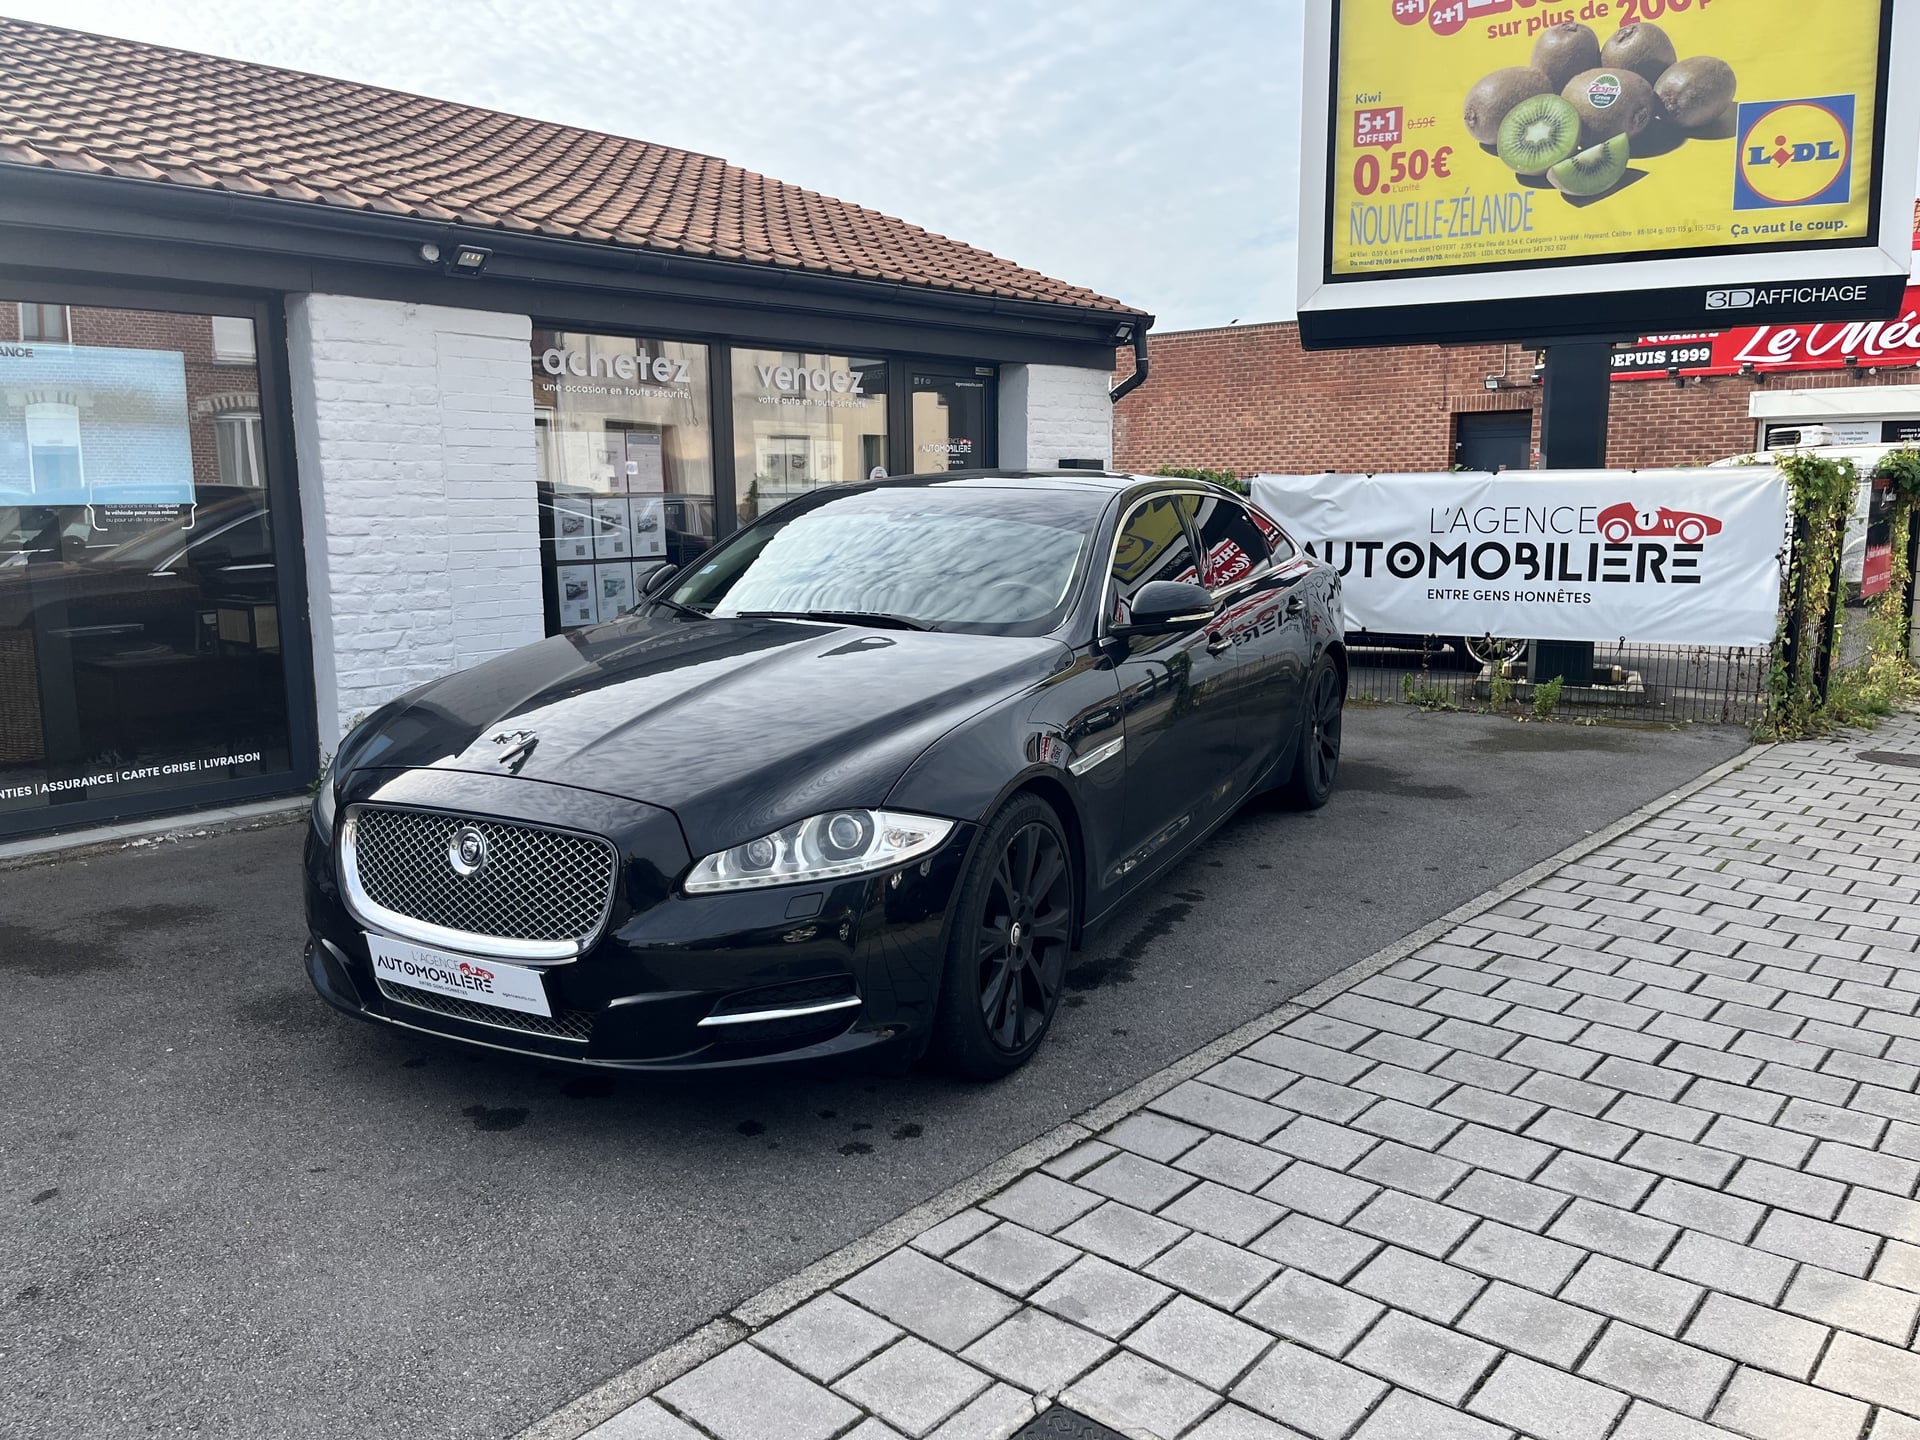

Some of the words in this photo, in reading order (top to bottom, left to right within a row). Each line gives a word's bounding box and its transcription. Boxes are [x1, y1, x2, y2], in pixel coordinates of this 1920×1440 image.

[1396, 0, 1425, 15] 5+1
[1433, 2, 1464, 25] 2+1
[1487, 19, 1522, 39] sur
[1526, 9, 1575, 37] plus
[1579, 1, 1609, 21] de
[1355, 92, 1382, 104] Kiwi
[1358, 111, 1396, 133] 5+1
[1407, 116, 1436, 130] 0.59€
[1357, 131, 1399, 144] OFFERT
[1353, 146, 1454, 196] 0.50€
[1350, 187, 1536, 246] NOUVELLE-ZÉLANDE
[1731, 224, 1749, 238] Ça
[1753, 222, 1786, 234] vaut
[1790, 220, 1803, 231] le
[1807, 220, 1848, 232] coup.
[1755, 285, 1868, 305] AFFICHAGE
[1671, 347, 1710, 363] 1999
[1733, 326, 1801, 363] Le
[542, 347, 691, 383] achetez
[757, 358, 864, 394] vendez
[543, 383, 561, 391] une
[565, 383, 607, 394] occasion
[610, 387, 622, 395] en
[625, 387, 650, 396] toute
[758, 395, 779, 405] votre
[781, 398, 800, 406] auto
[1430, 506, 1597, 534] L'AGENCE
[1642, 513, 1650, 526] 1
[1428, 589, 1469, 600] ENTRE
[1473, 590, 1510, 601] GENS
[1515, 588, 1591, 604] HONNÊTES
[40, 773, 114, 793] ASSURANCE
[122, 766, 160, 781] CARTE
[162, 761, 197, 774] GRISE
[204, 751, 261, 768] LIVRAISON
[411, 951, 460, 971] L'AGENCE
[378, 954, 494, 994] AUTOMOBILIERE
